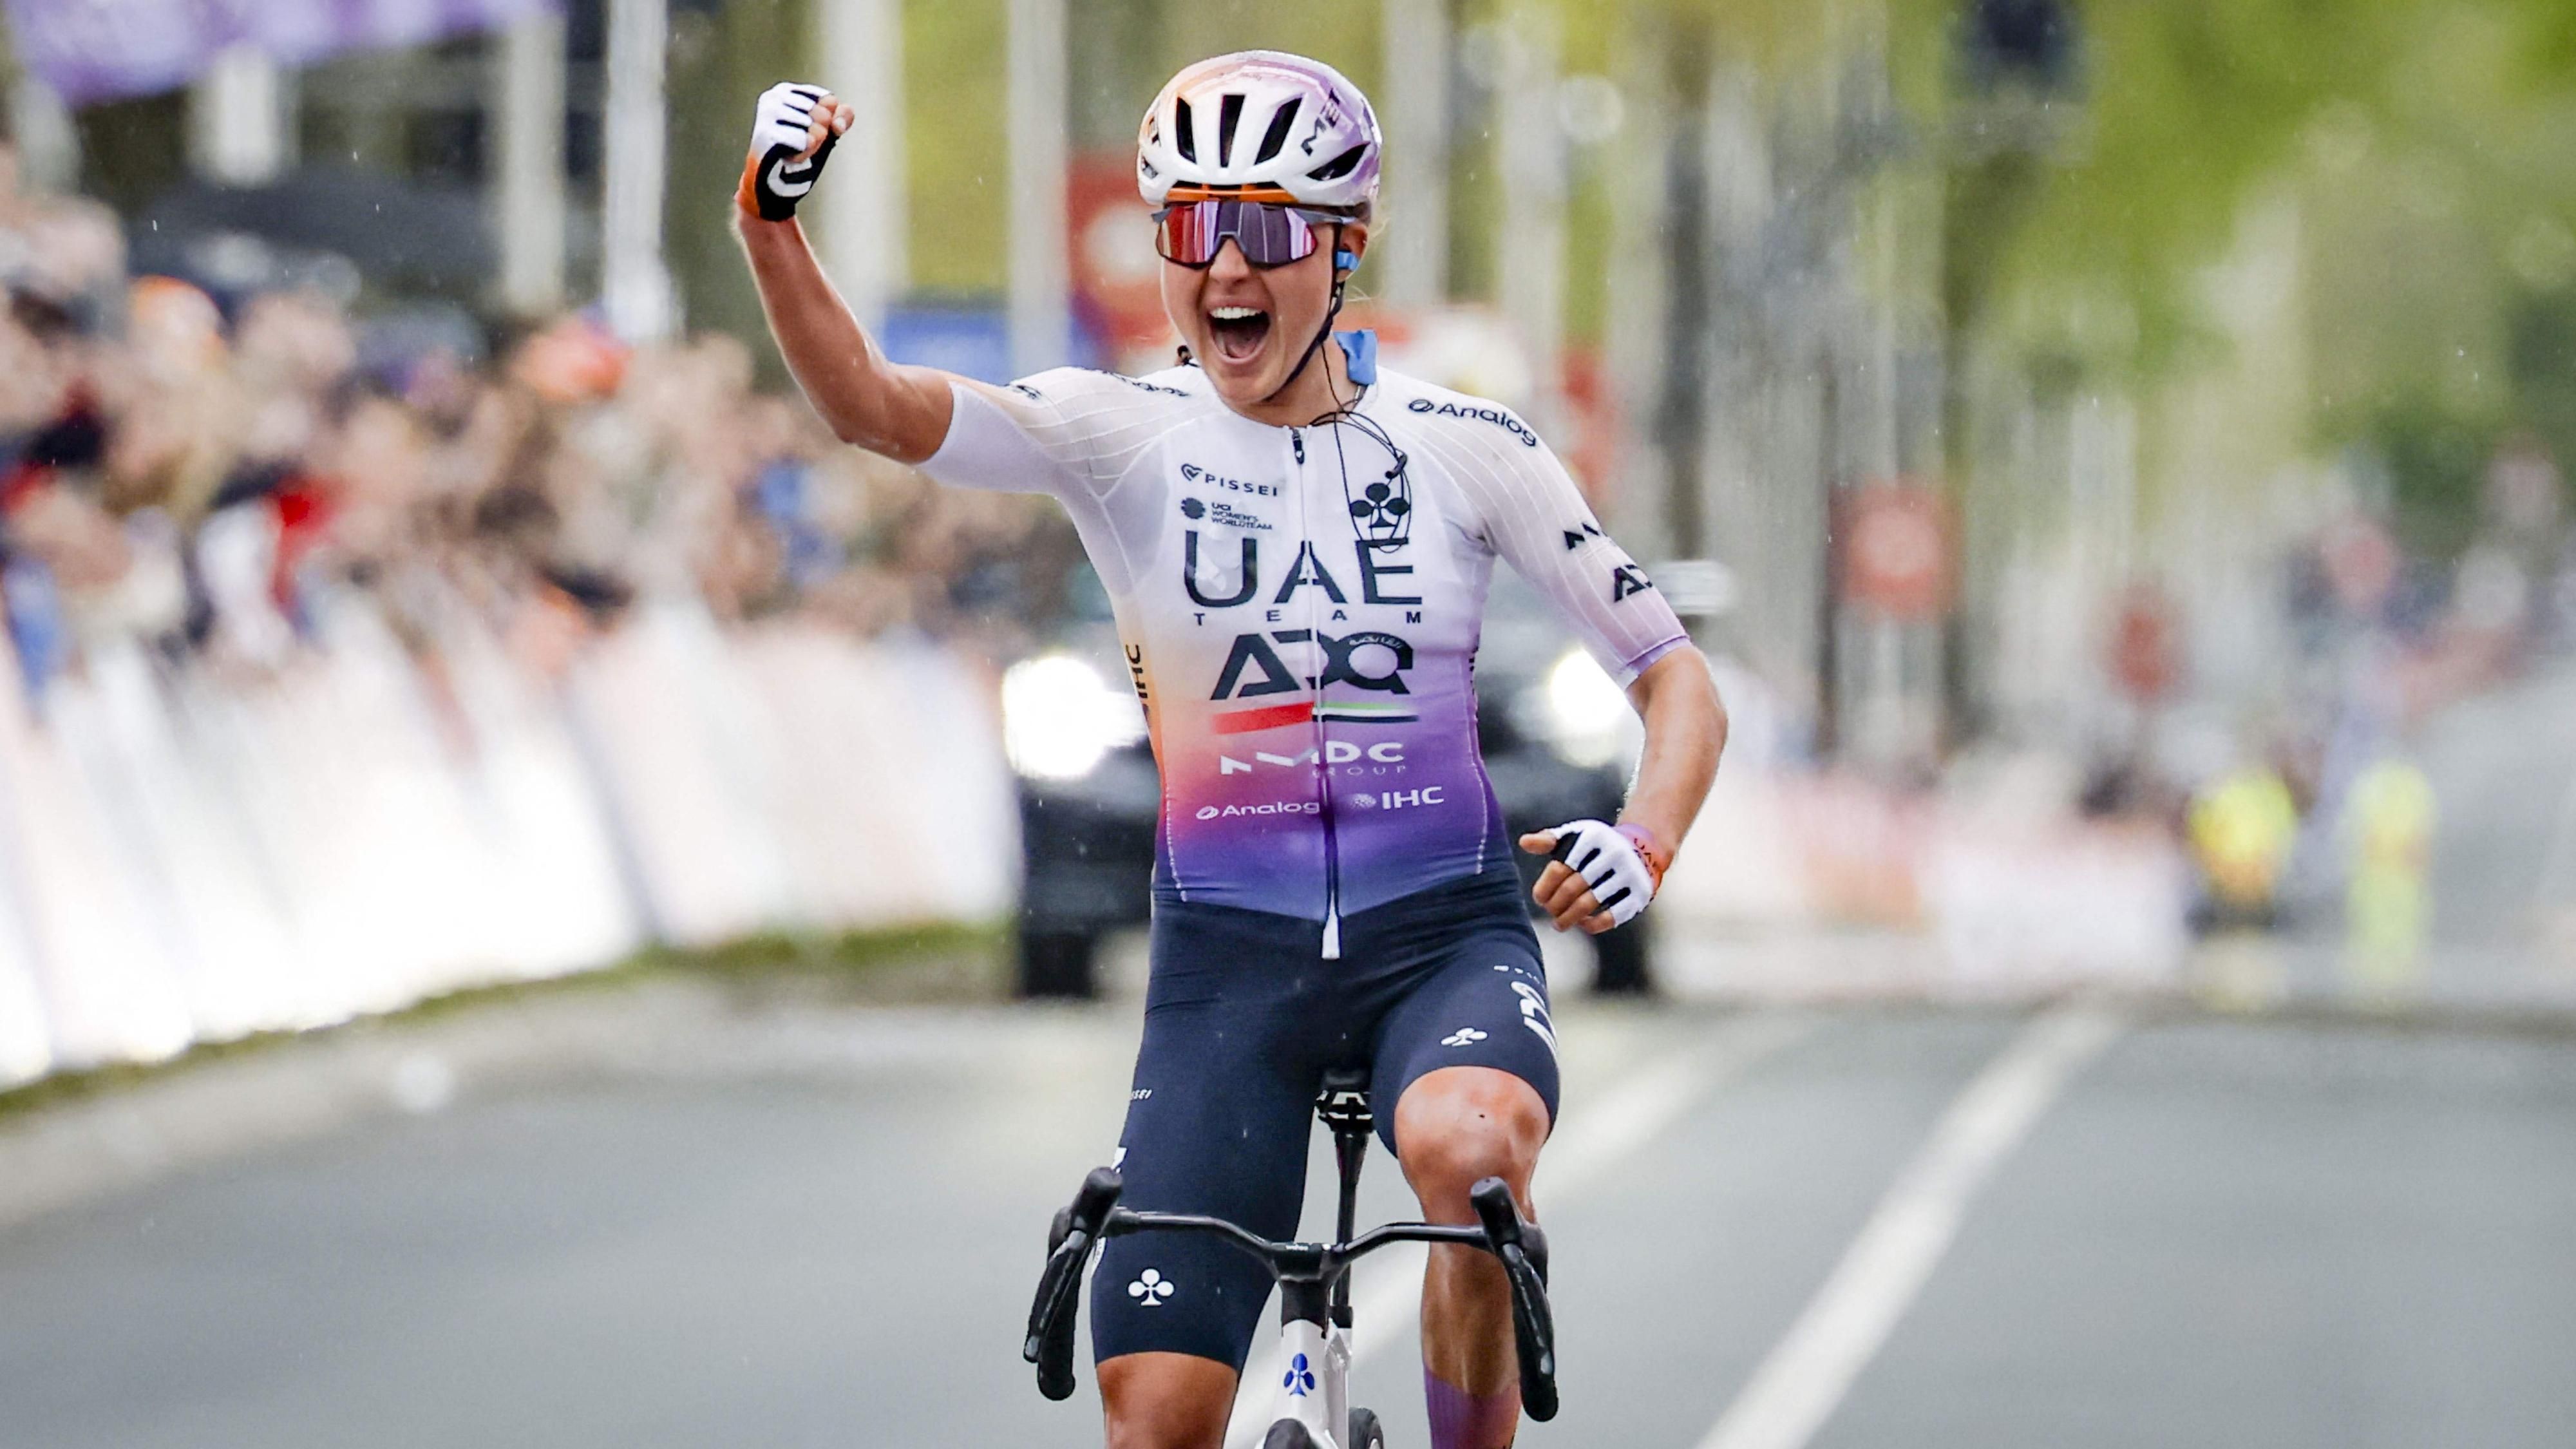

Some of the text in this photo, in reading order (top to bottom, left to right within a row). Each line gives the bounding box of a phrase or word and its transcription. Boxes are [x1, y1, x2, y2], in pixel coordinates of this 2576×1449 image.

[1437, 403, 1537, 447] Analog
[1205, 473, 1278, 497] PISSEI
[1211, 502, 1231, 511] UCI
[1211, 517, 1273, 530] WORLDTEAM
[1184, 530, 1422, 608] UAE
[1193, 610, 1421, 626] TEAM
[1209, 629, 1414, 701] ADQ
[1222, 800, 1320, 817] Analog
[1382, 786, 1444, 810] IHC
